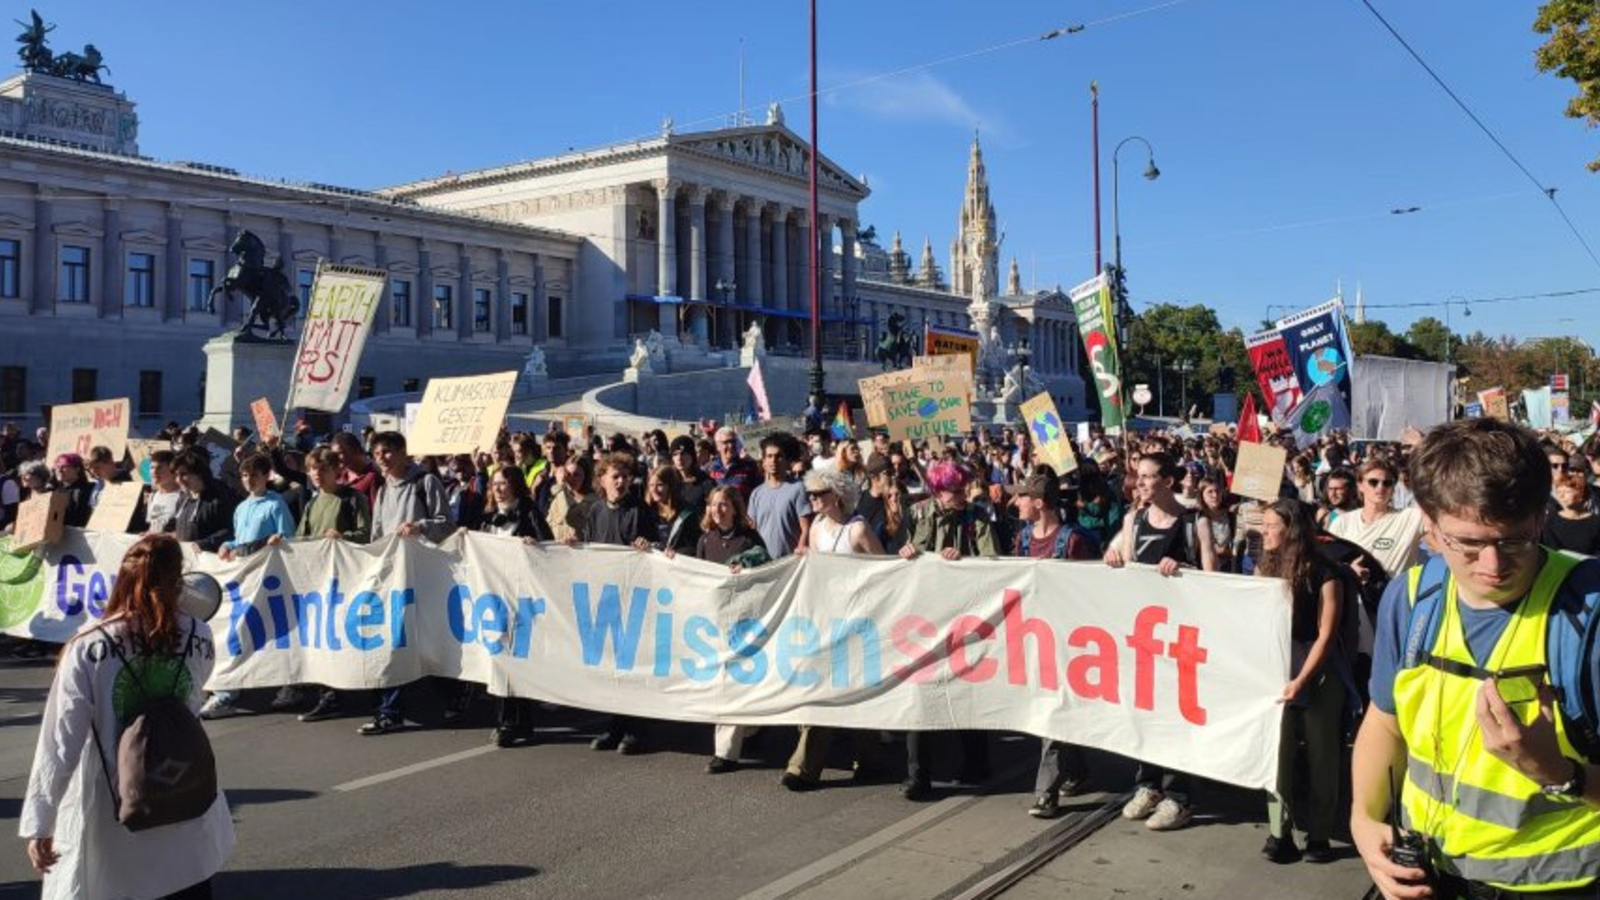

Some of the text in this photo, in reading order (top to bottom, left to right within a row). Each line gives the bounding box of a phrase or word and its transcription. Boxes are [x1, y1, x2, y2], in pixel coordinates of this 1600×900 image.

[1298, 333, 1334, 352] PLANET
[434, 381, 514, 403] KLIMASCHUTZ
[888, 386, 920, 403] TIME
[928, 381, 944, 393] TO
[438, 406, 486, 424] GESETZ
[888, 401, 917, 421] SAVE
[906, 419, 958, 437] FUTURE
[225, 573, 418, 659] hinter
[572, 582, 1209, 727] Wissenschaft
